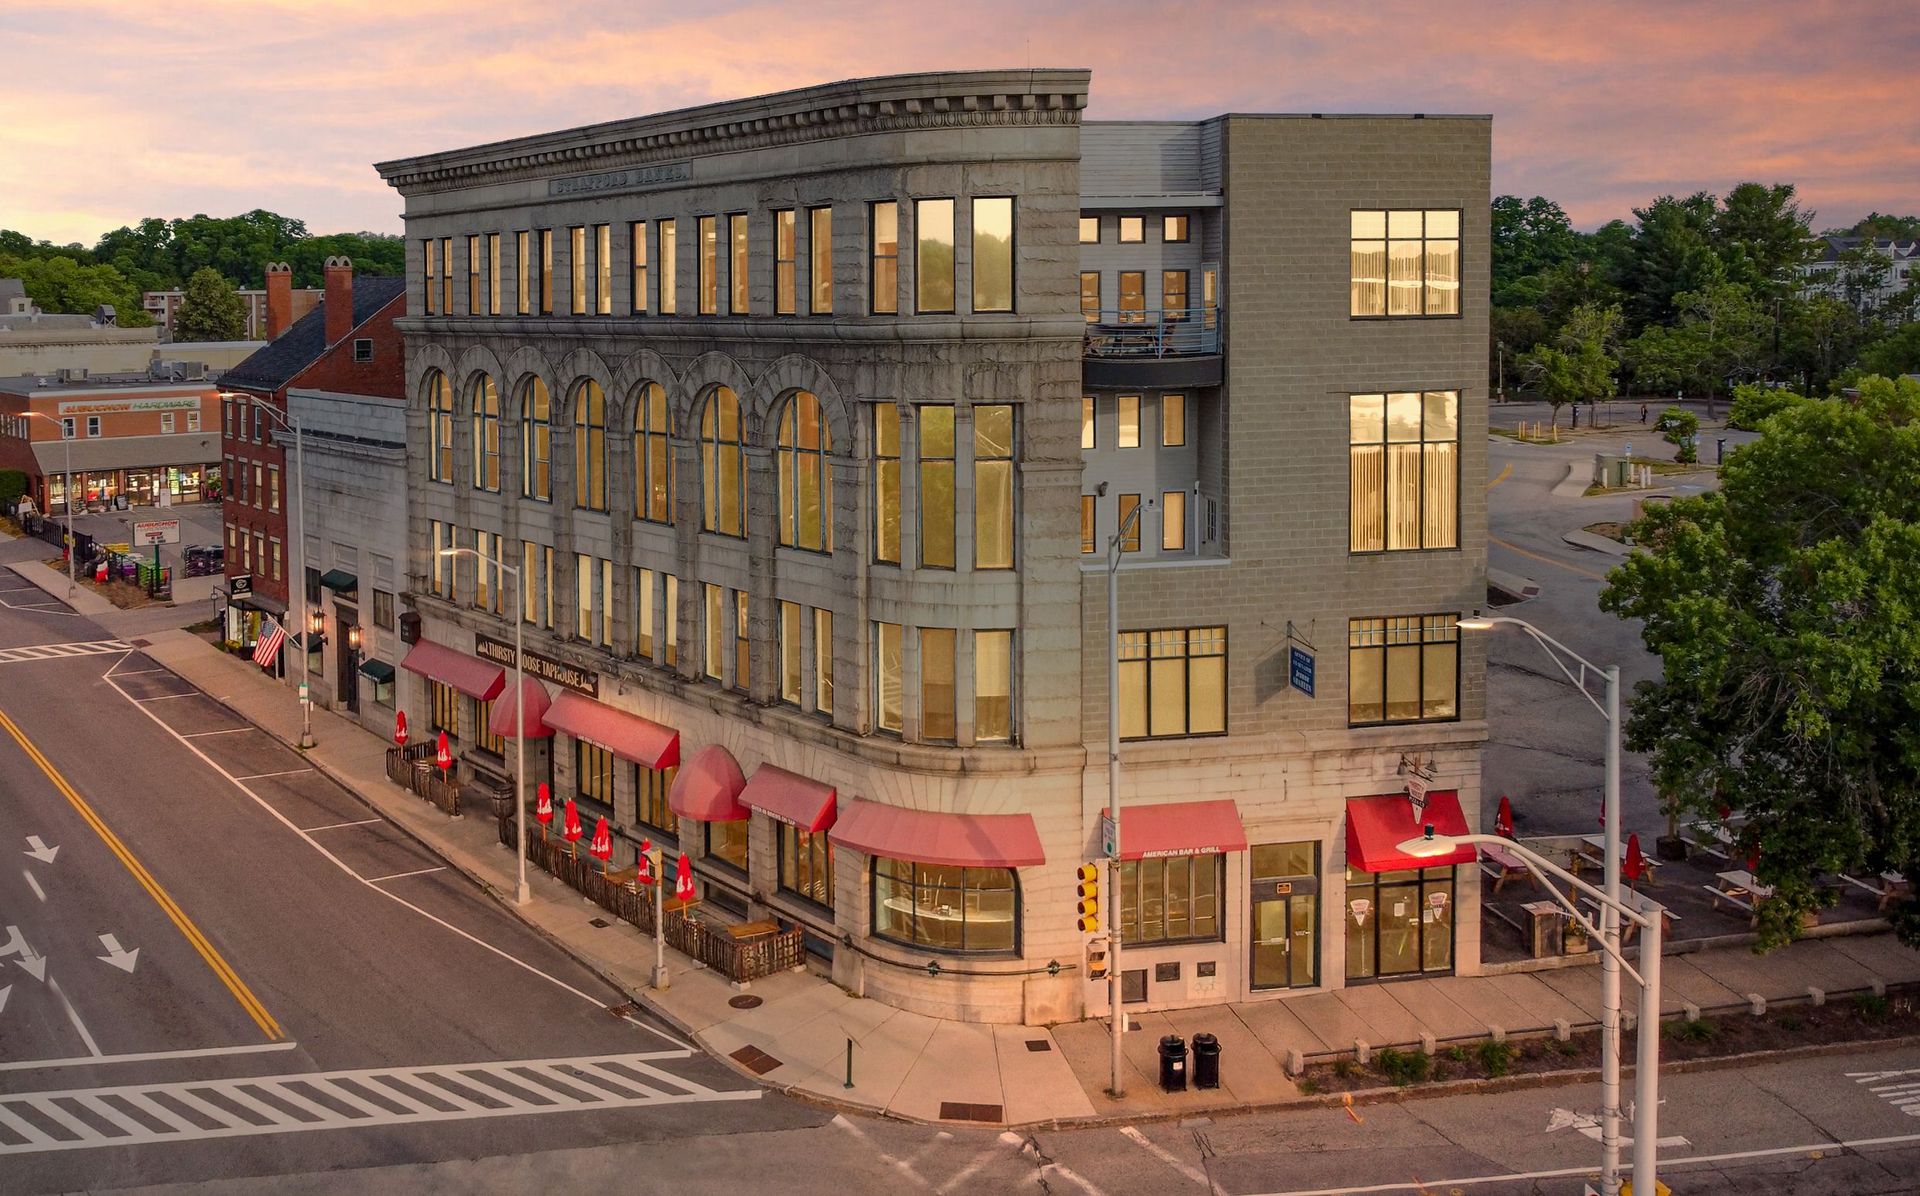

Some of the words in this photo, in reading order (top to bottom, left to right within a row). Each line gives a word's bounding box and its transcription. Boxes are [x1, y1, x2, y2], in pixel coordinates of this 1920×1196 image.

[63, 403, 132, 414] AUBUCHON
[133, 400, 197, 410] HARDWARE
[136, 520, 178, 529] AUBUCHON
[487, 642, 516, 664] THIRSTY
[522, 654, 541, 674] OOSE
[1142, 850, 1178, 859] AMERICAN
[1179, 848, 1194, 856] BAR
